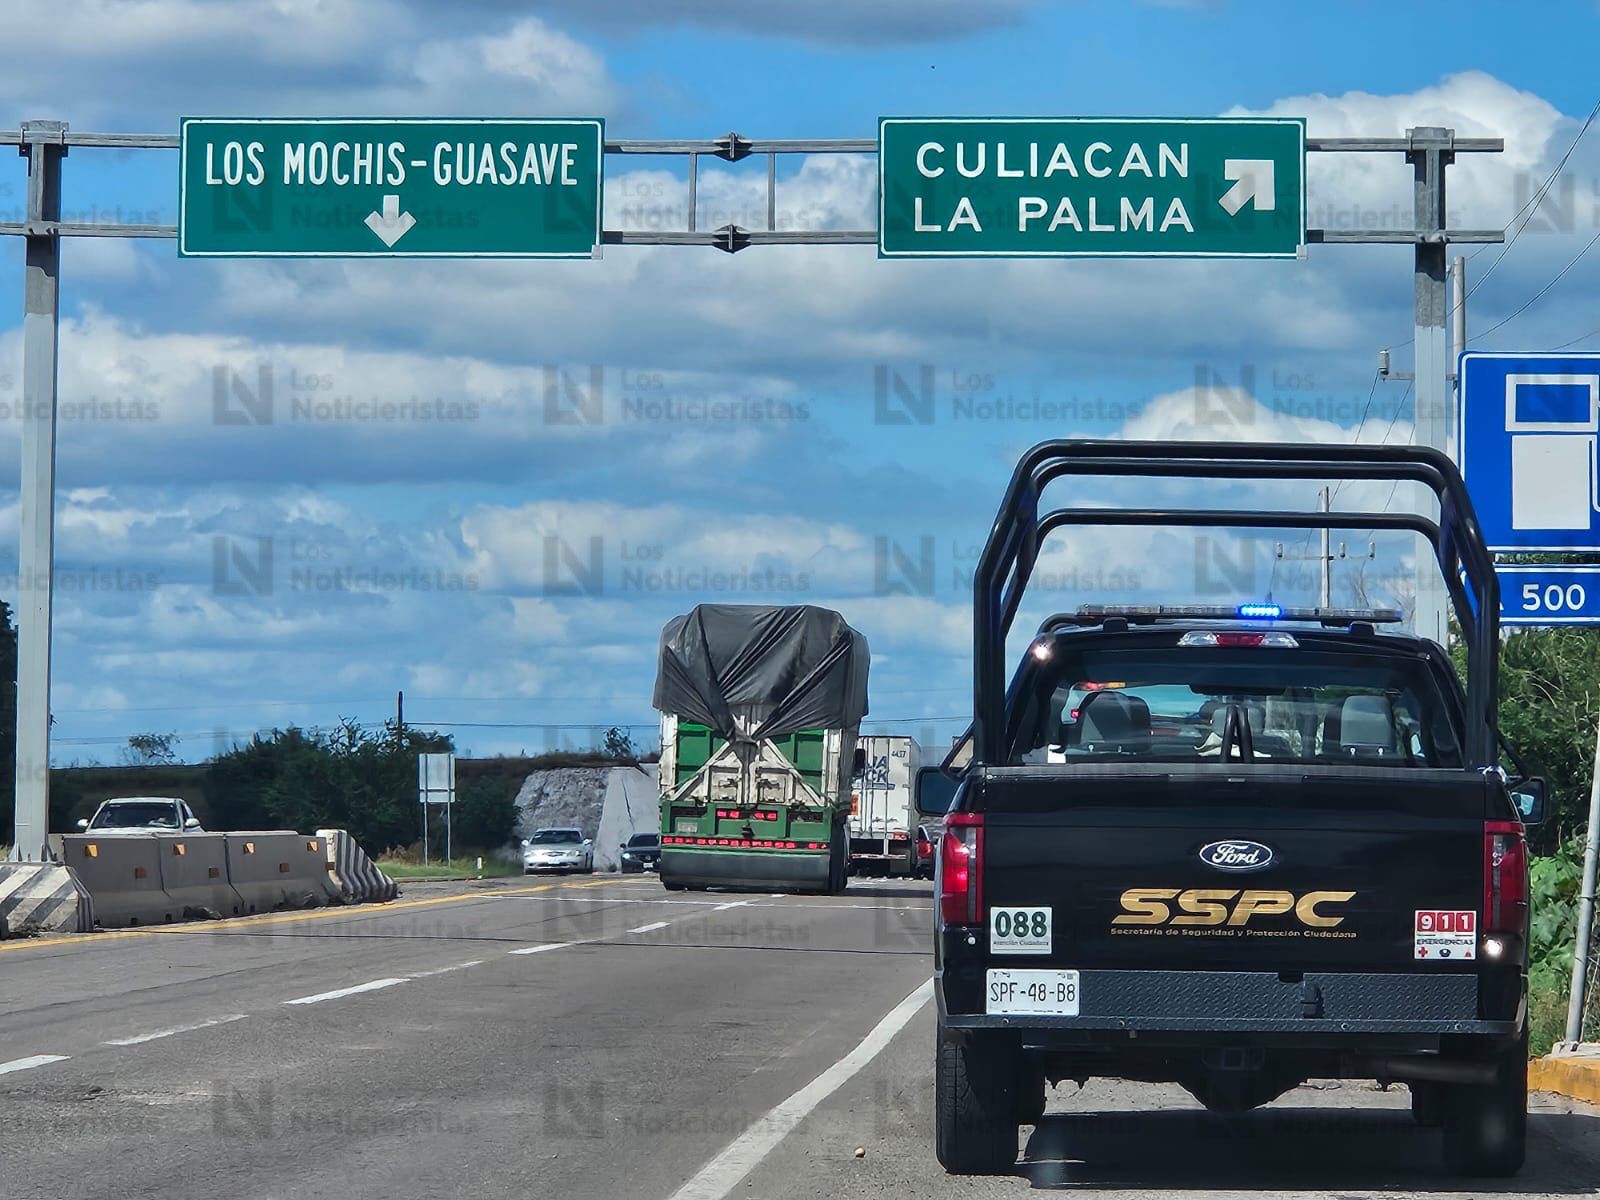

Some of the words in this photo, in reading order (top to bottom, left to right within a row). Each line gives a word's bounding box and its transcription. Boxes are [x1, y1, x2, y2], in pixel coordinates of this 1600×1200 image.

[206, 142, 264, 185] LOS
[283, 142, 578, 185] MOCHIS-GUASAVE
[916, 142, 1188, 178] CULIACAN
[914, 197, 982, 232] LA
[1018, 197, 1194, 232] PALMA
[1522, 583, 1585, 610] 500
[1210, 842, 1260, 865] Ford
[1111, 888, 1357, 927] SSPC
[995, 911, 1047, 937] 088
[1181, 928, 1235, 937] Seguridad
[1420, 914, 1470, 930] 911
[990, 982, 1076, 1003] SPF-48-B8
